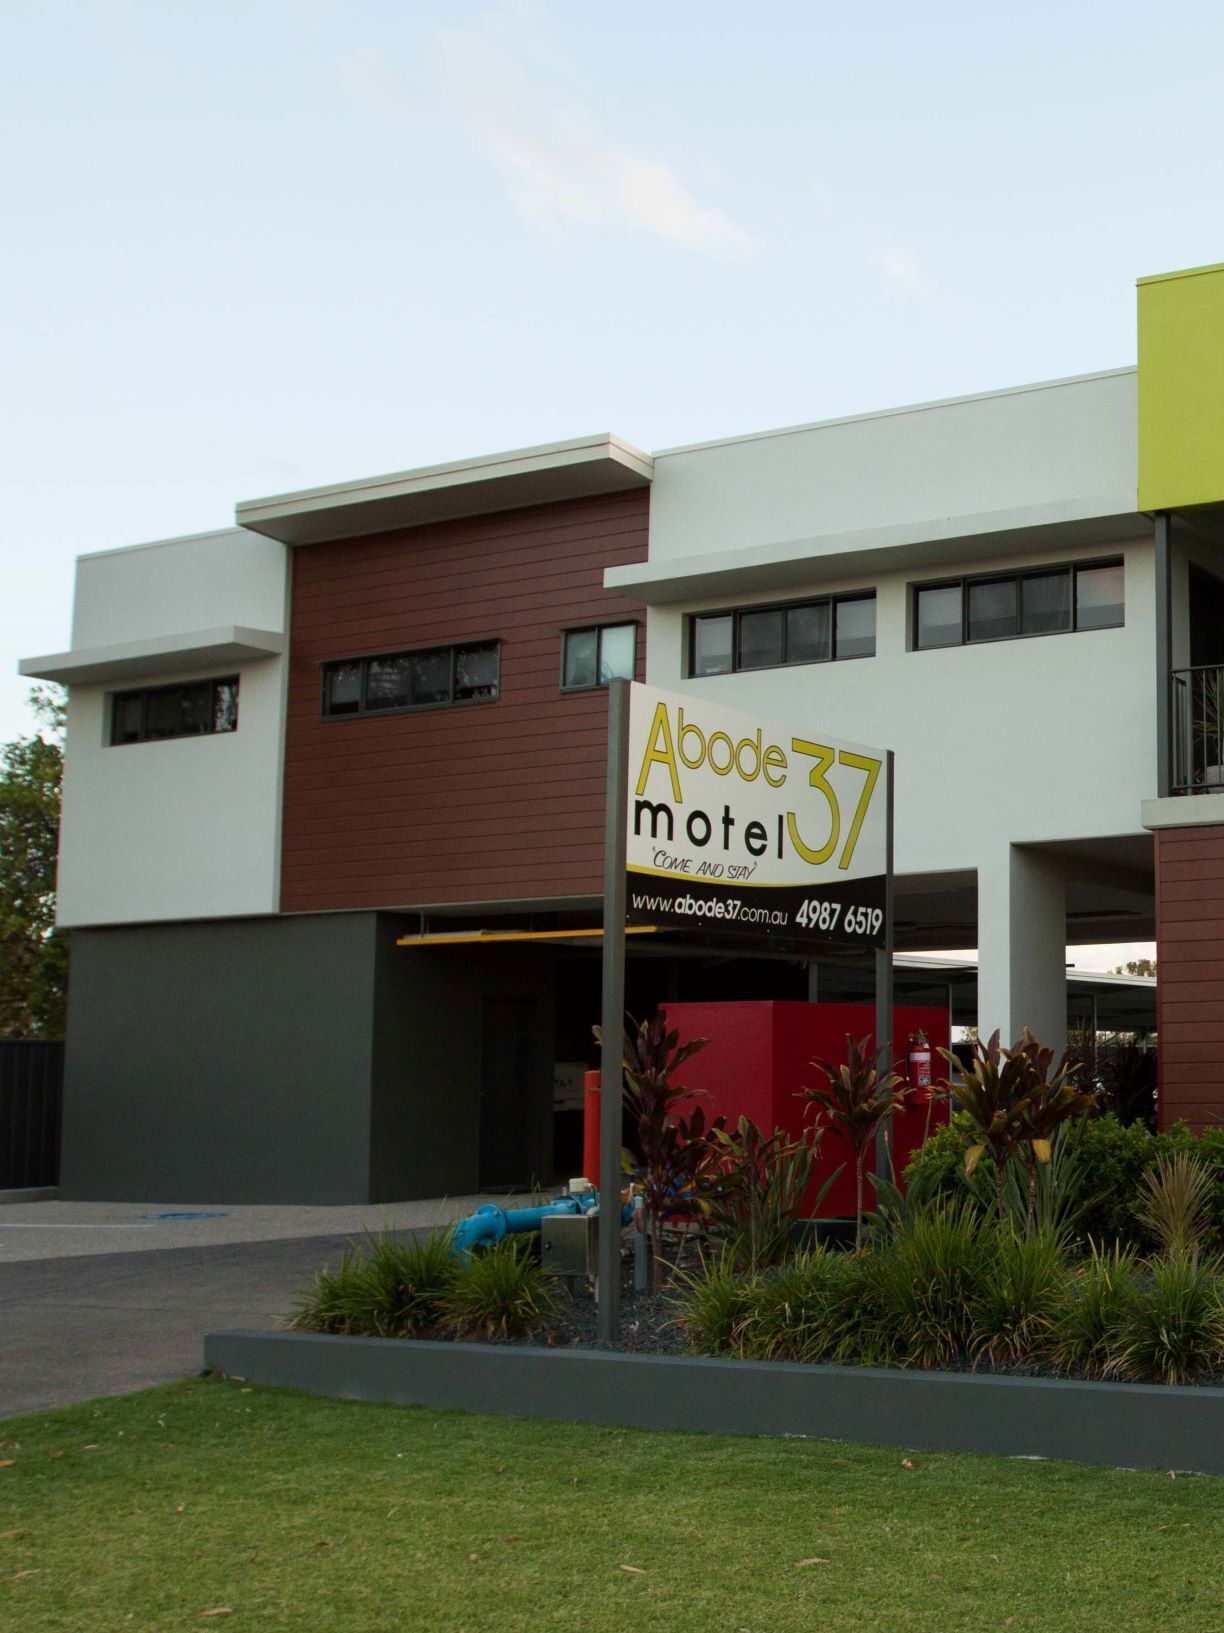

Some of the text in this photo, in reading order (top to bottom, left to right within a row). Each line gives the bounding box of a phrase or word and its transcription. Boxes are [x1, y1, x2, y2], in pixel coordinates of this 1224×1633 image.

[635, 702, 882, 871] Abode 37
[633, 799, 784, 859] motel
[696, 861, 725, 878] AND
[632, 893, 883, 935] www.abode37.com.au 4987 6519
